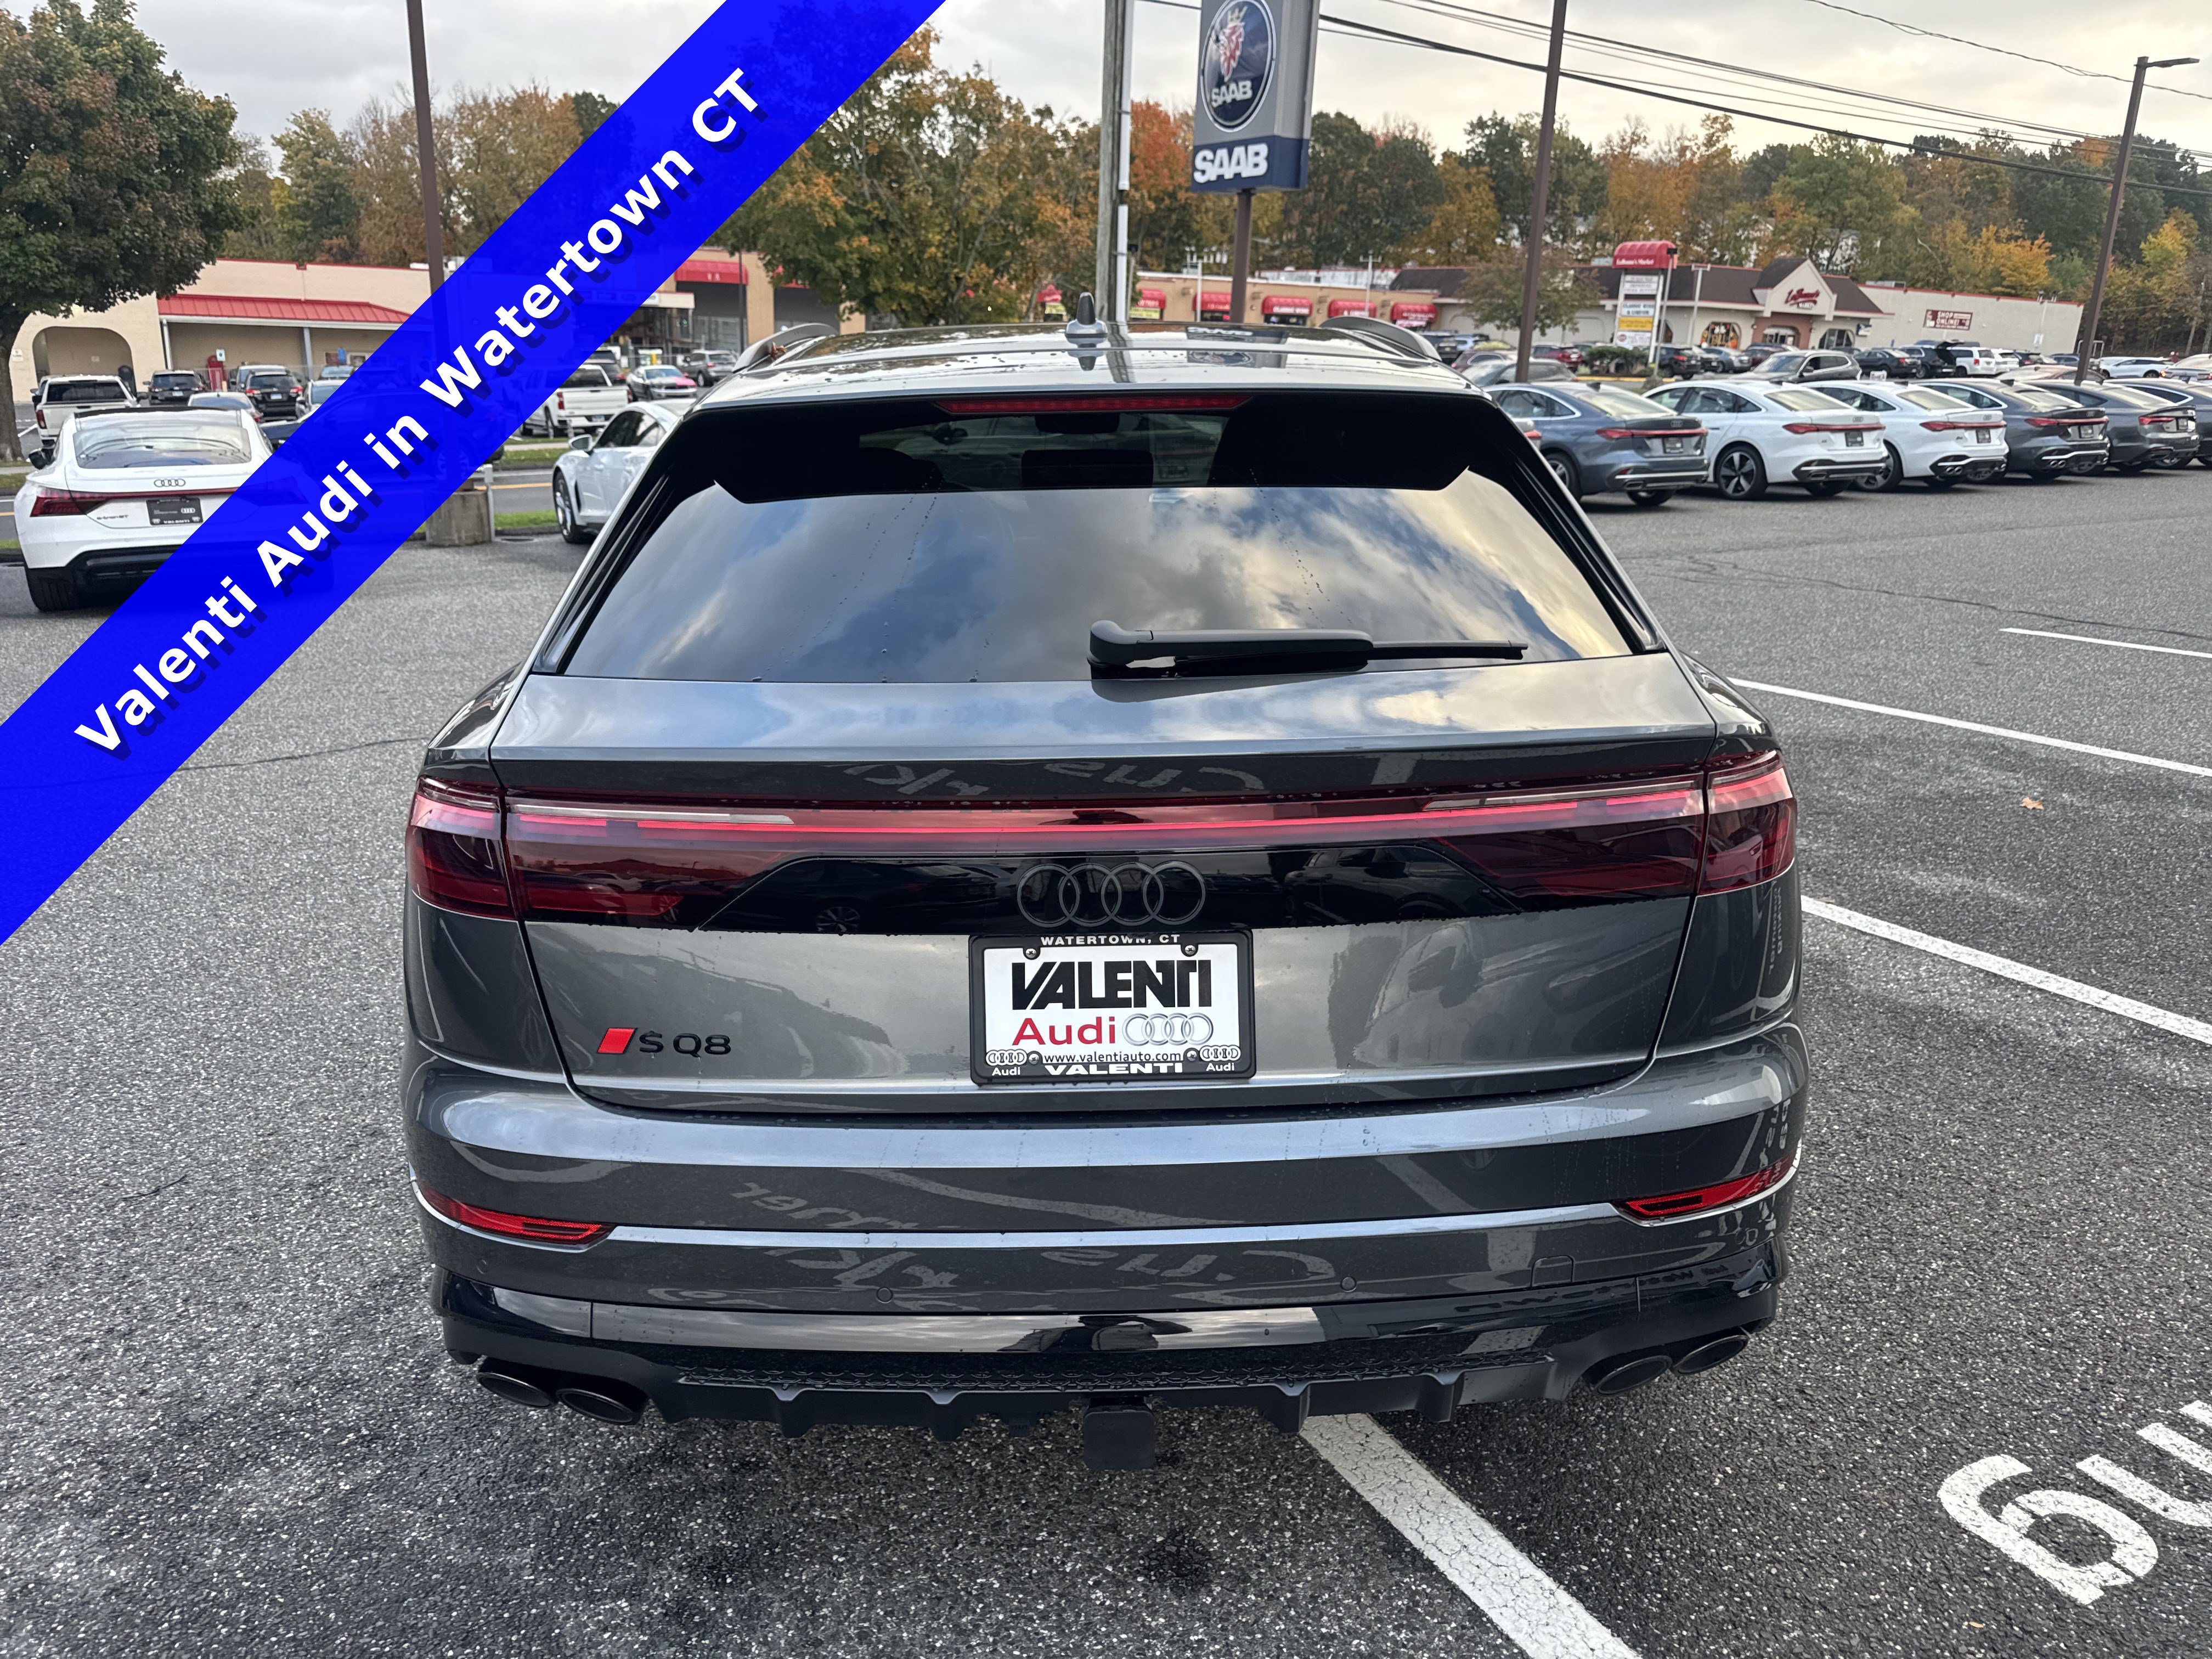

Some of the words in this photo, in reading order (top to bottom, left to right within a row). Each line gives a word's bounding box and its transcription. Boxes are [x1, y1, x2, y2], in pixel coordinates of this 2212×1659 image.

[1211, 80, 1252, 107] SAAB
[1194, 143, 1268, 183] SAAB
[1159, 934, 1180, 943] CT
[1012, 960, 1211, 1011] VALENTI
[1012, 1016, 1116, 1046] Audi
[1044, 1051, 1181, 1062] www.valentiauto.com
[992, 1066, 1020, 1076] Audi
[1045, 1062, 1182, 1075] VALENTI
[1206, 1062, 1234, 1071] Audi
